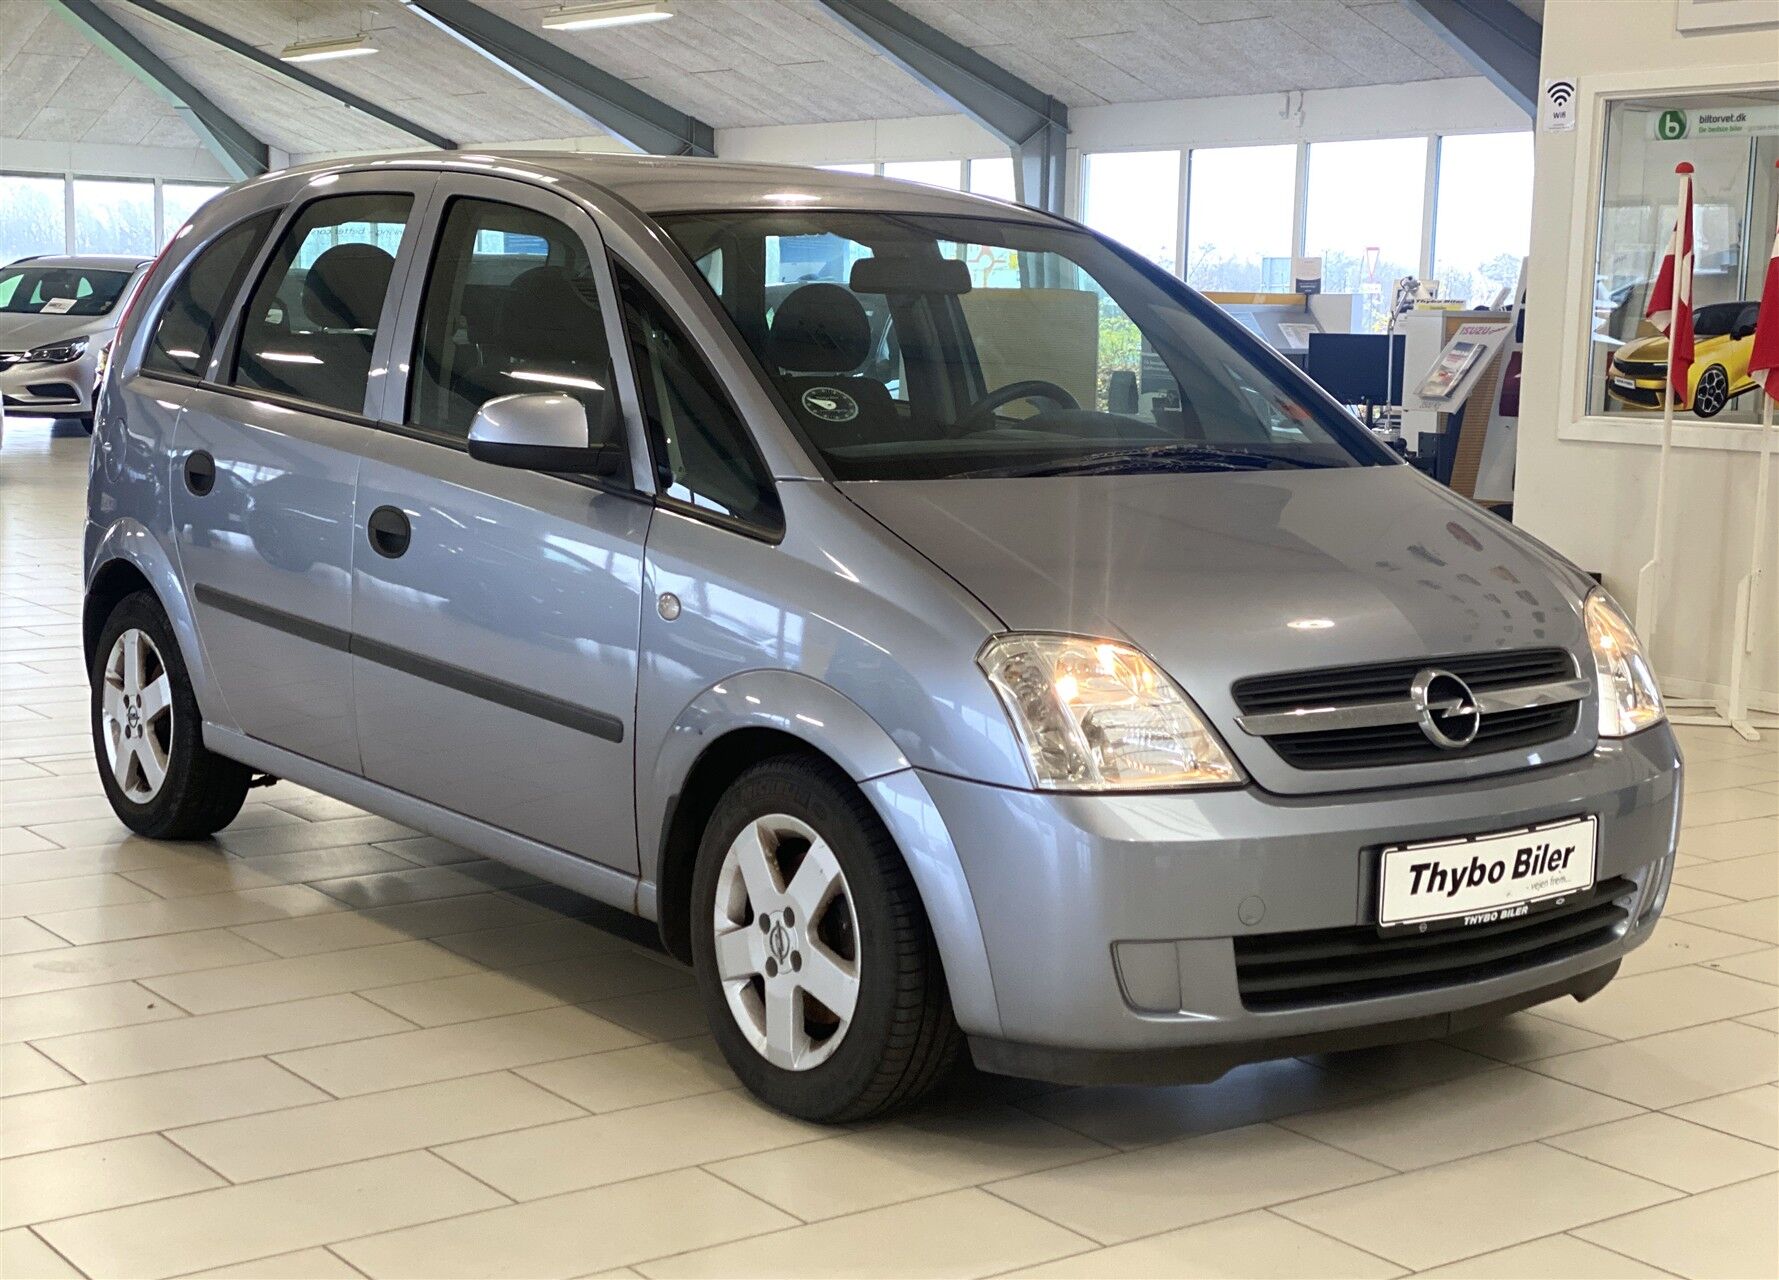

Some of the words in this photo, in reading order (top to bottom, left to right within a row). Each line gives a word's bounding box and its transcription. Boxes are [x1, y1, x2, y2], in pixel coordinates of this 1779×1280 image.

[1553, 111, 1566, 119] Wifi
[1699, 113, 1746, 124] biltorvet.dk
[1459, 326, 1491, 336] ISUZU
[1409, 856, 1506, 898] Thybo
[1511, 843, 1576, 880] Biler
[1463, 911, 1498, 926] THYBO
[1499, 905, 1529, 920] BILER
